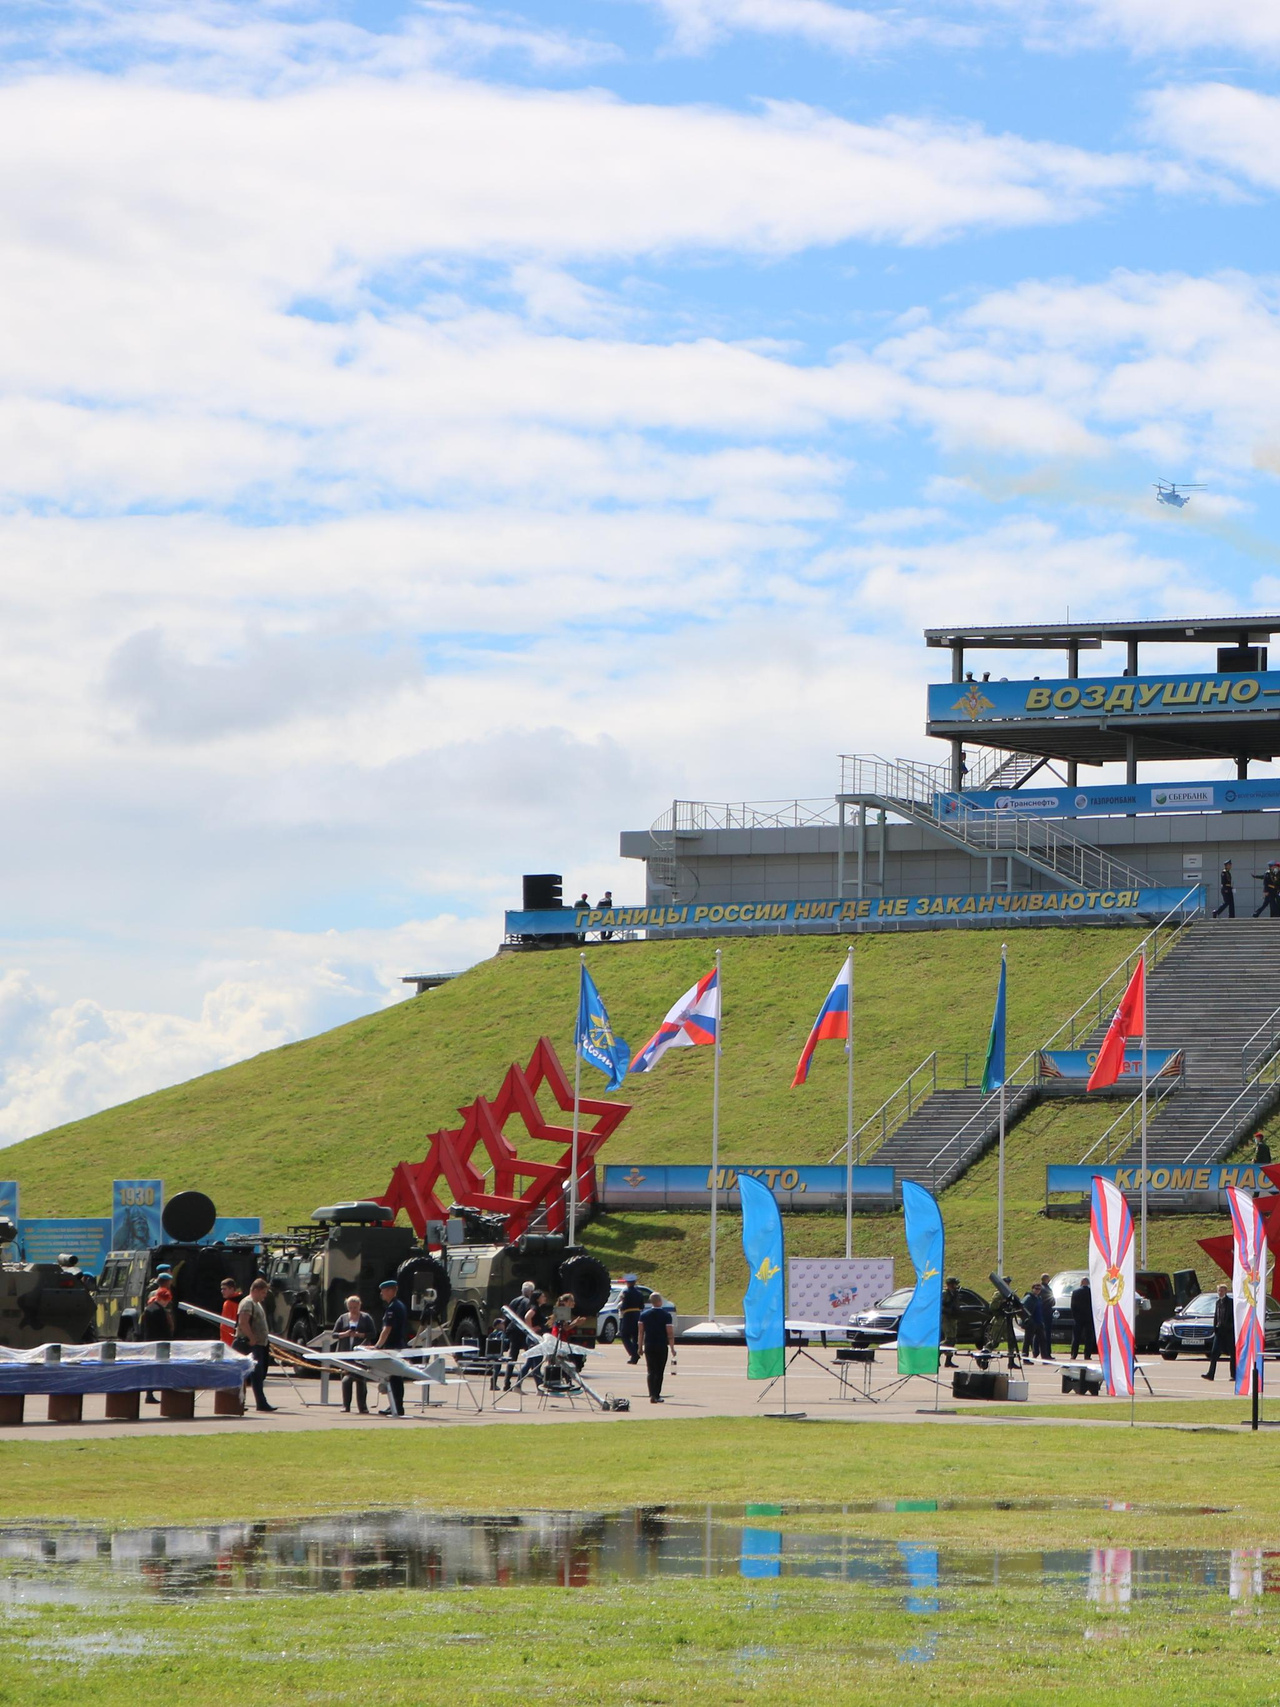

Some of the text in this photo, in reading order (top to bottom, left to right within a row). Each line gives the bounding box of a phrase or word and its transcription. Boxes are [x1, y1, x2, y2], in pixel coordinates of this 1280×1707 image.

[1009, 799, 1056, 809] Транснефть
[1090, 795, 1137, 806] ГАЗПРОМБАНК
[1168, 792, 1208, 801] СБЕРБАНК
[575, 890, 1141, 928] ГРАНИЦЫ РОССИИ НИГДЕ НЕ ЗАКАНЧИВАЮТСЯ!
[1114, 1167, 1211, 1190] КРОМЕ
[119, 1187, 155, 1207] 1930
